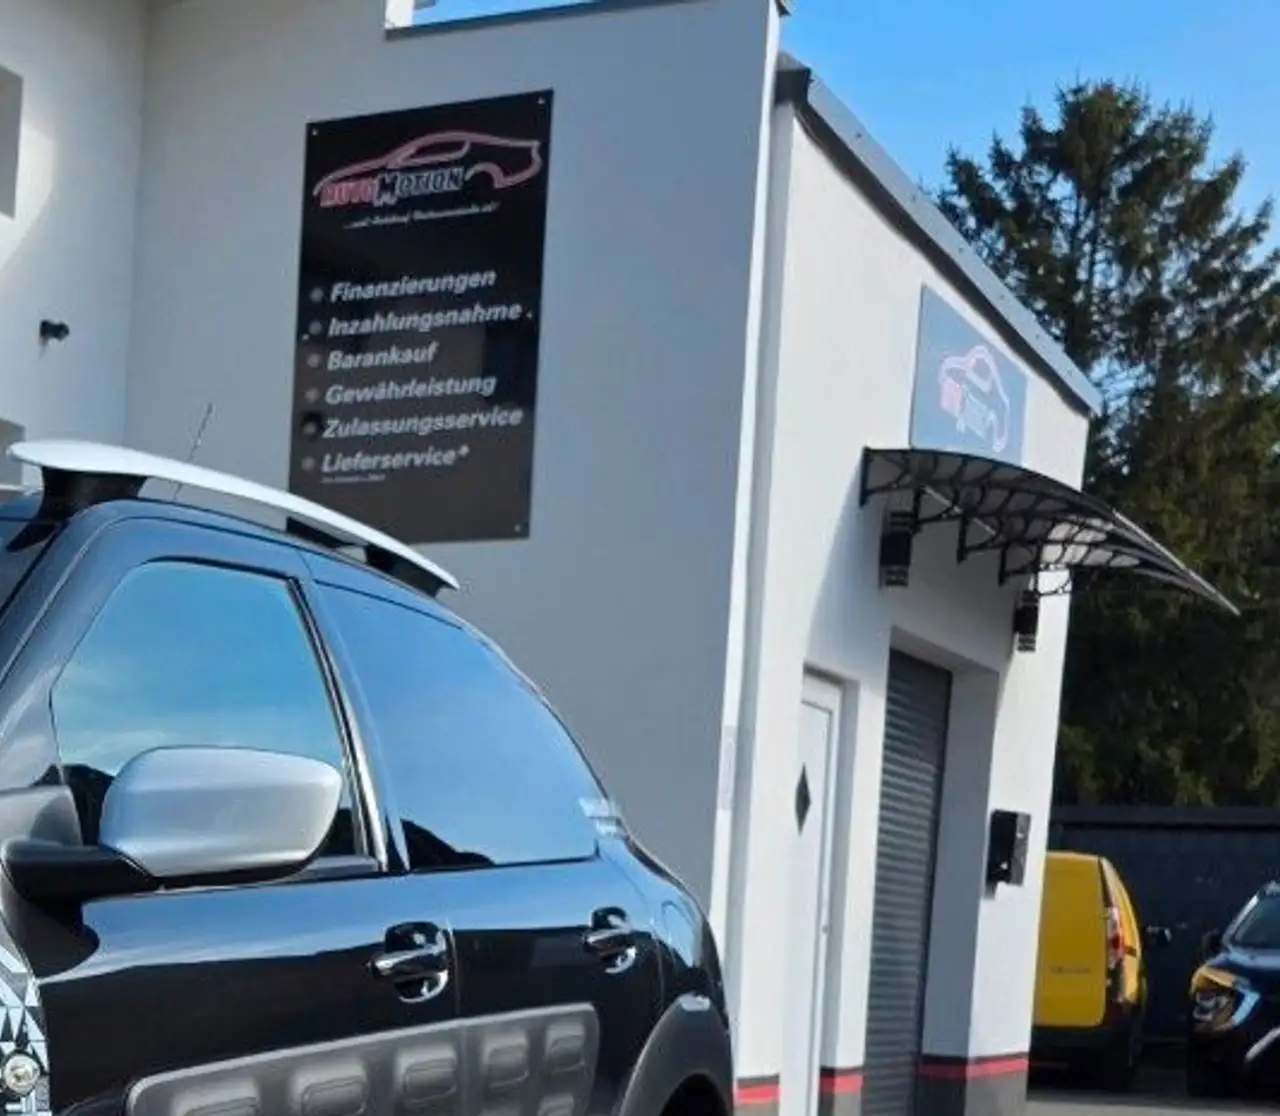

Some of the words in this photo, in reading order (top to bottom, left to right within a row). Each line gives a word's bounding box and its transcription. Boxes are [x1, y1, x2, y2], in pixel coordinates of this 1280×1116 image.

[330, 270, 496, 303] Finanzierungen
[328, 303, 523, 337] Inzahlungsnahme
[327, 341, 438, 371] Barankauf
[324, 376, 497, 405] Gewährleistung
[322, 404, 524, 439] Zulassungsservice
